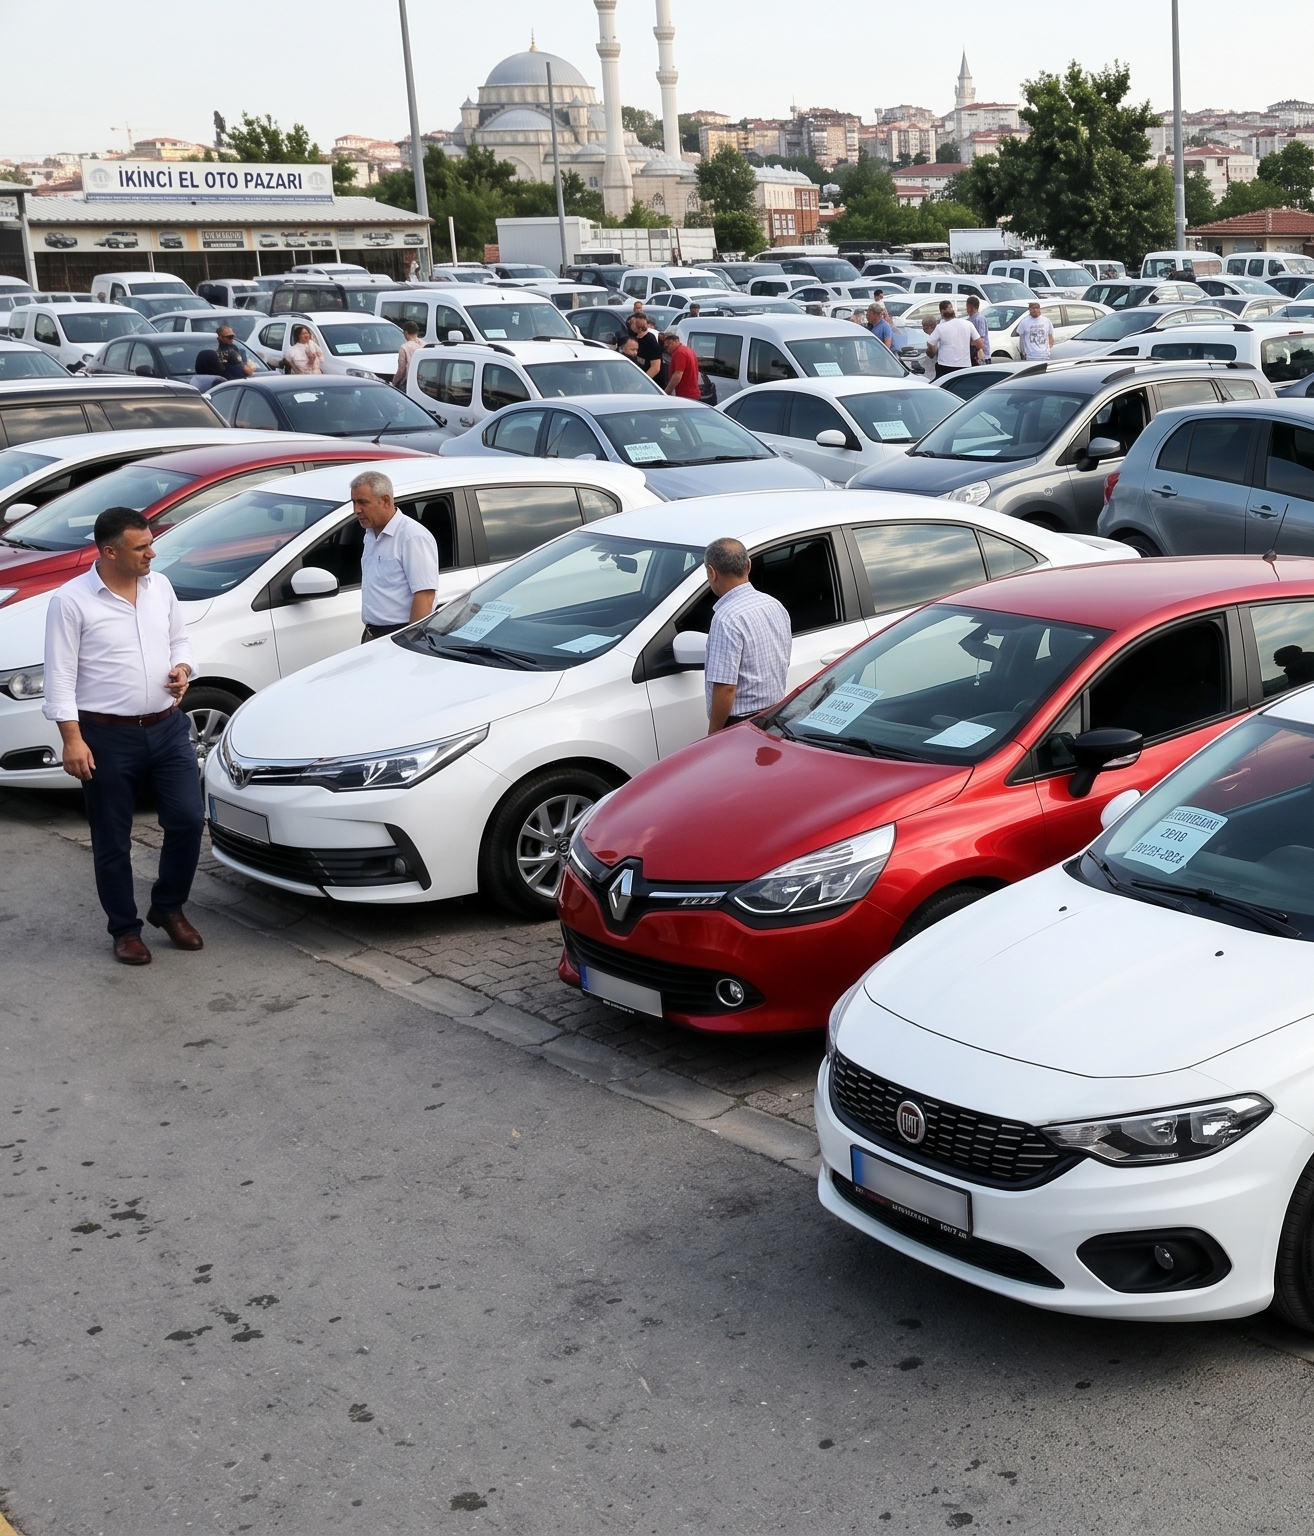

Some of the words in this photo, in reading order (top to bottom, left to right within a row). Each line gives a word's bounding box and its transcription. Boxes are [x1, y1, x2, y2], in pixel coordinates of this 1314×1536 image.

[118, 166, 173, 188] İKİNCİ
[178, 171, 200, 188] EL
[204, 171, 239, 189] OTO
[244, 172, 302, 190] PAZARI
